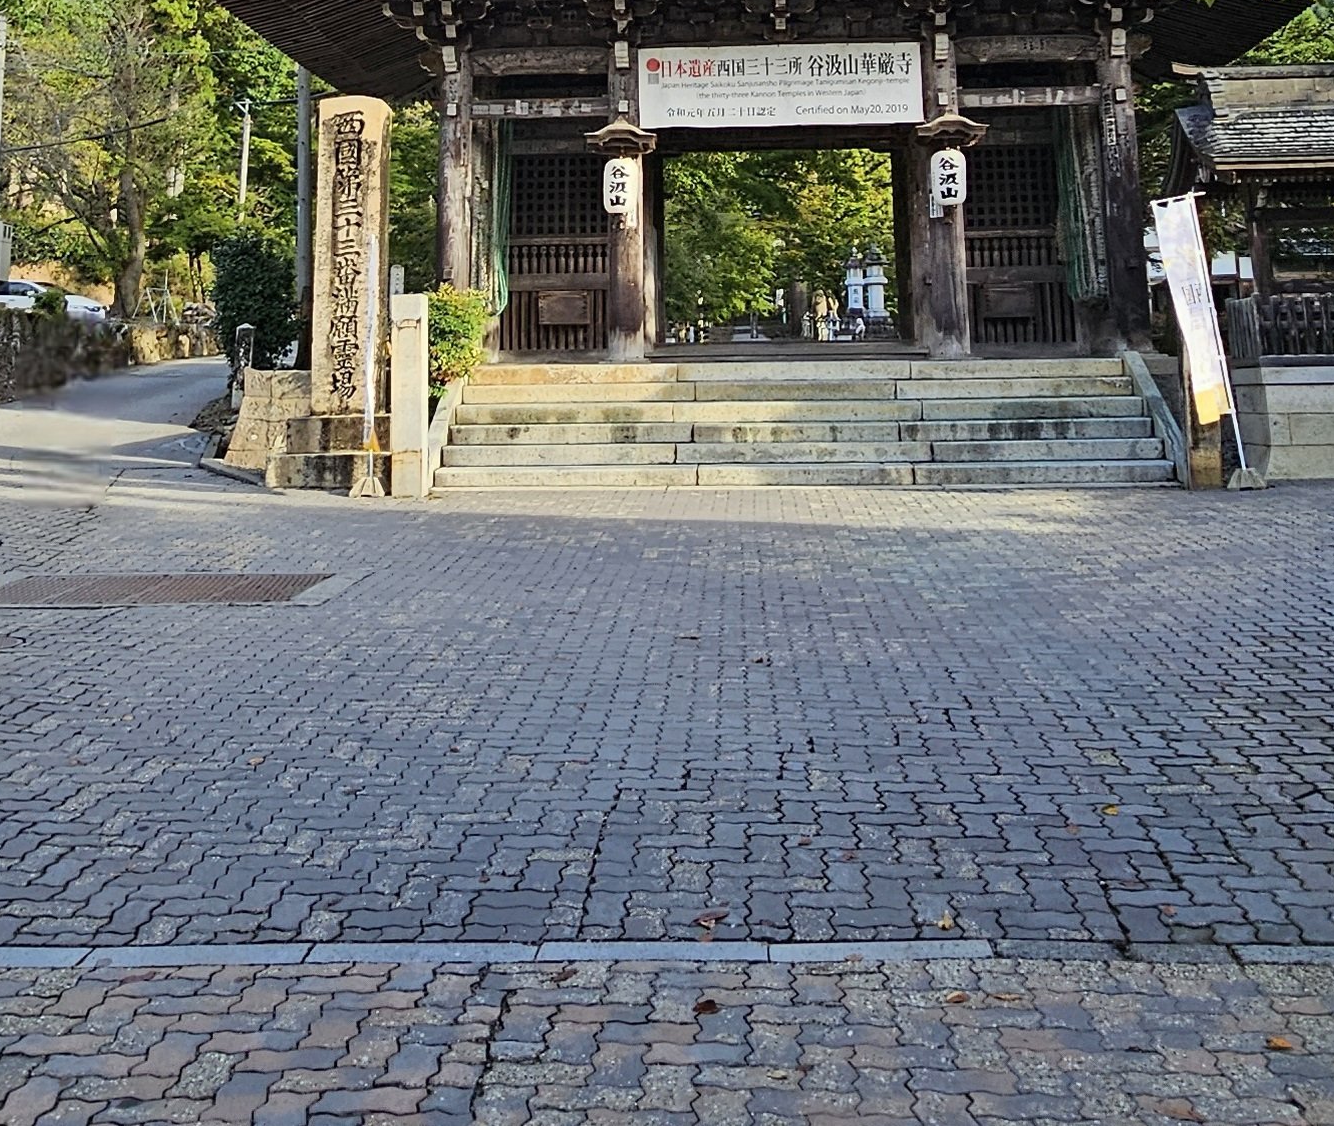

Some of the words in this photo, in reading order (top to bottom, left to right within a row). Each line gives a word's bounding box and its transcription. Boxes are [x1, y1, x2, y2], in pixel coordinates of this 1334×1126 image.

[807, 52, 913, 77] 谷汲山華厳寺
[795, 105, 835, 115] Certified
[836, 106, 849, 114] on
[885, 103, 909, 113] 2019
[609, 165, 629, 207] 谷汲山
[938, 156, 959, 199] 谷汲山
